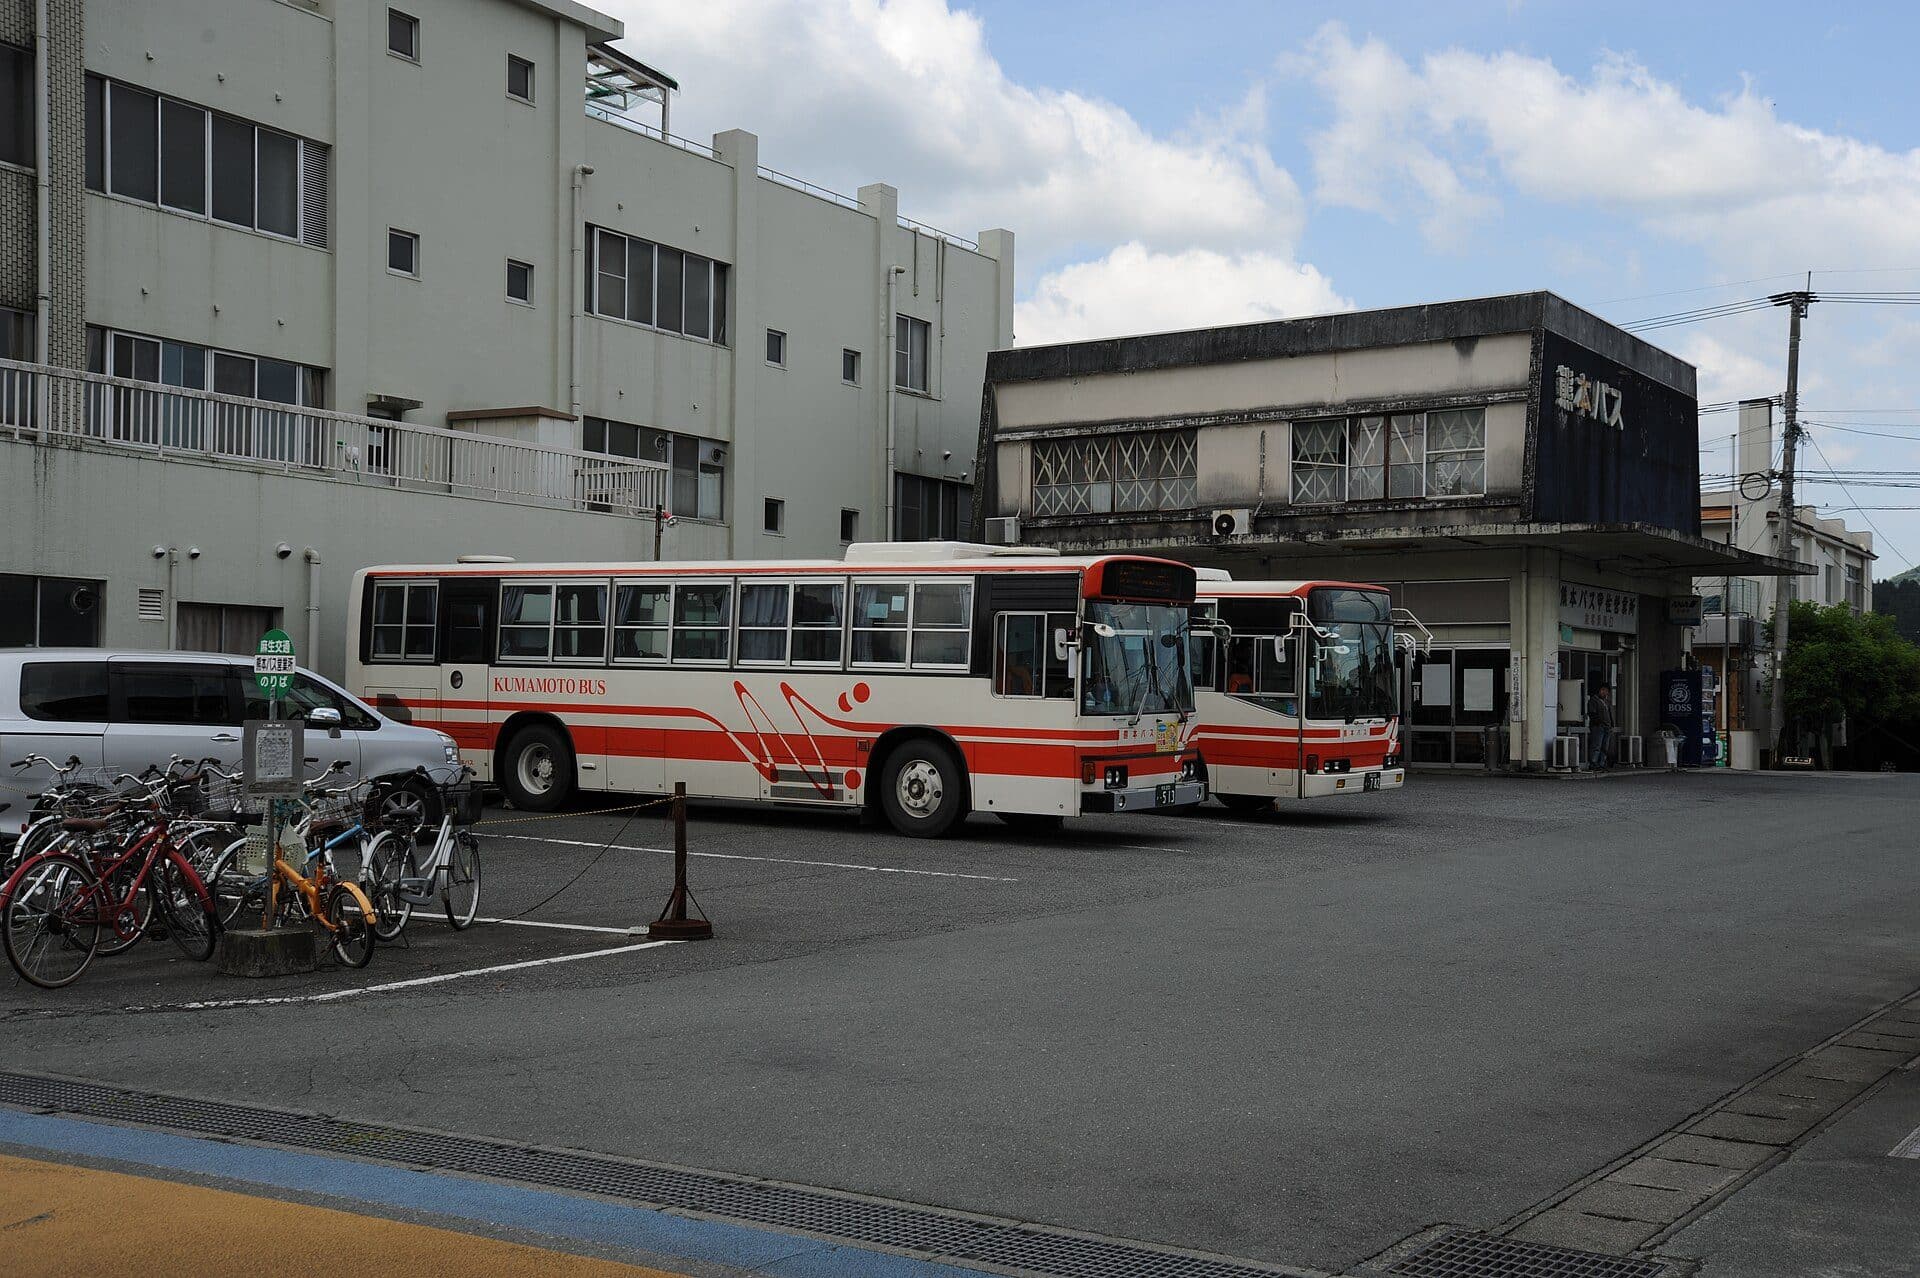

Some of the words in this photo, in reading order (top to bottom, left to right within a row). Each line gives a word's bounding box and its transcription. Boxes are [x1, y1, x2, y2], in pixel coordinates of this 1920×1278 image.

[1554, 364, 1624, 431] 熊本バス
[260, 639, 290, 654] 麻生交通
[256, 656, 294, 673] 熊本バス営業所
[260, 675, 288, 688] のりば
[494, 677, 576, 694] KUMAMOTO
[579, 679, 606, 695] BUS
[1668, 703, 1692, 712] BOSS
